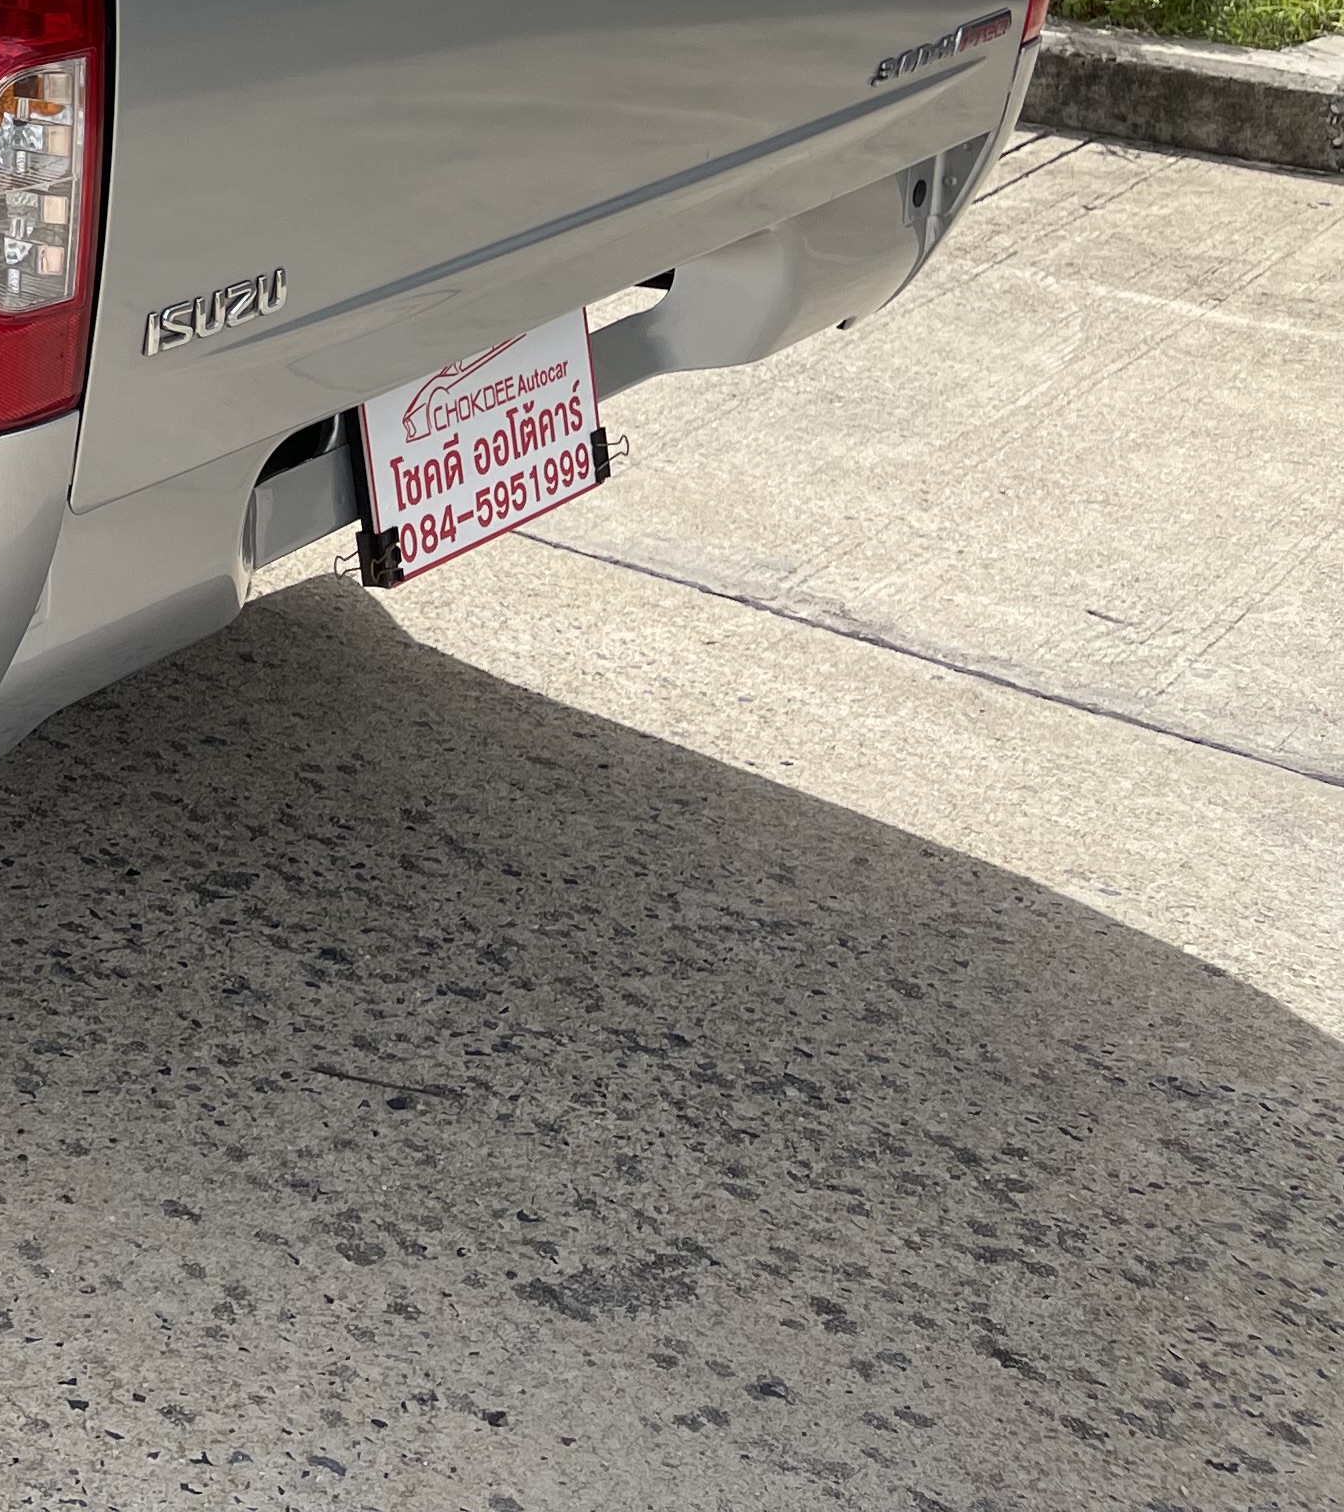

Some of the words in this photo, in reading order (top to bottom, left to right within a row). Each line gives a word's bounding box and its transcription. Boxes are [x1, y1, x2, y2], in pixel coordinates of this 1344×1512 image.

[142, 268, 288, 357] ISUZU
[389, 432, 465, 512] โชคดี
[473, 379, 585, 476] ออโต้คาร์
[433, 376, 516, 432] CHOKDEE
[517, 359, 569, 397] Autocar
[399, 441, 590, 564] 084-5951999
